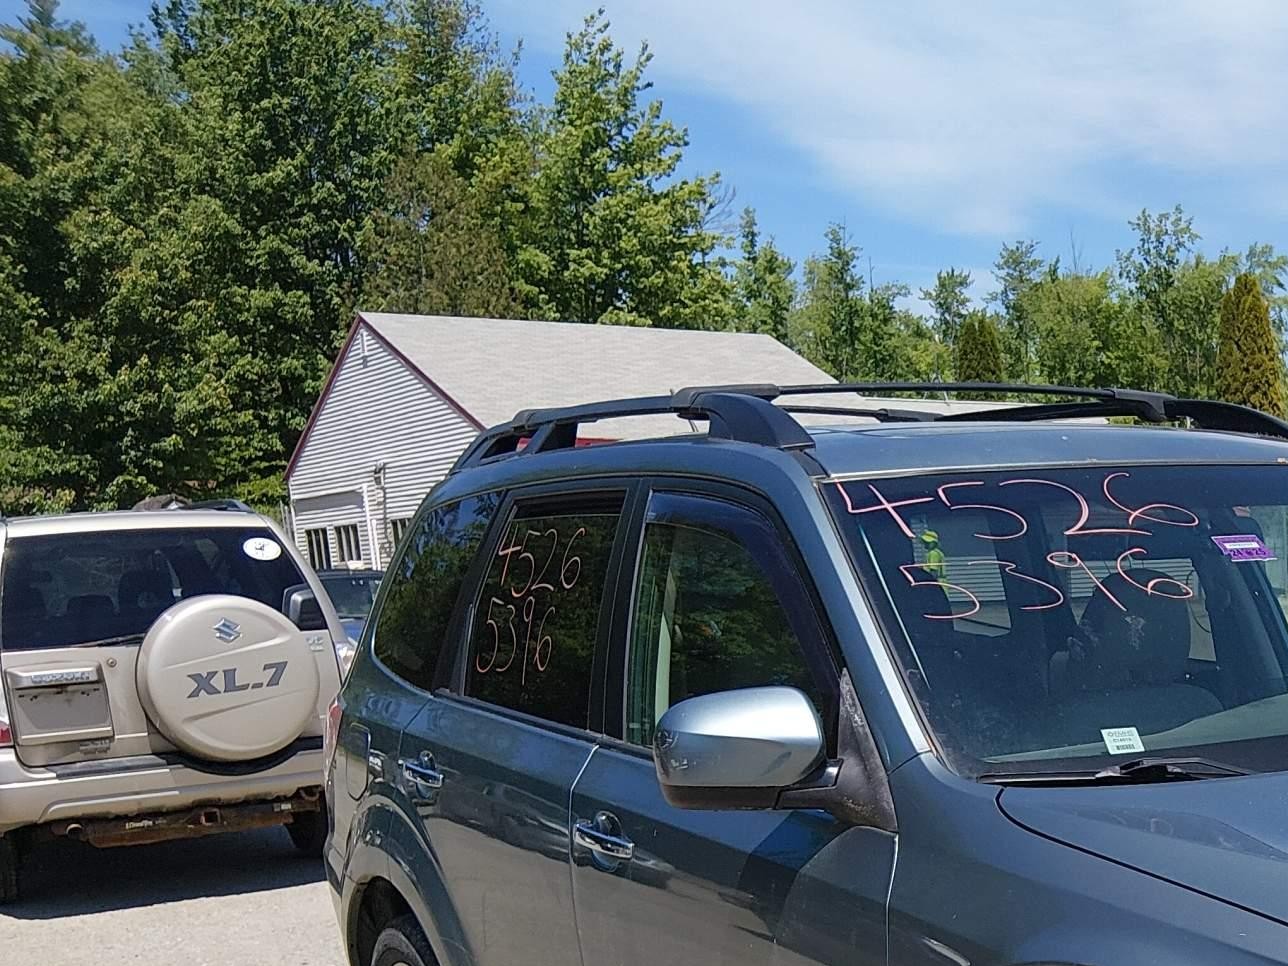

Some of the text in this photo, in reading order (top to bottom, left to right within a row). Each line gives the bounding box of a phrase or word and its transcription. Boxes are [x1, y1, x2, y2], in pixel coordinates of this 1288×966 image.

[836, 472, 1200, 539] 4526
[498, 523, 587, 598] 4526
[899, 547, 1194, 620] 5396
[476, 596, 556, 686] 5396
